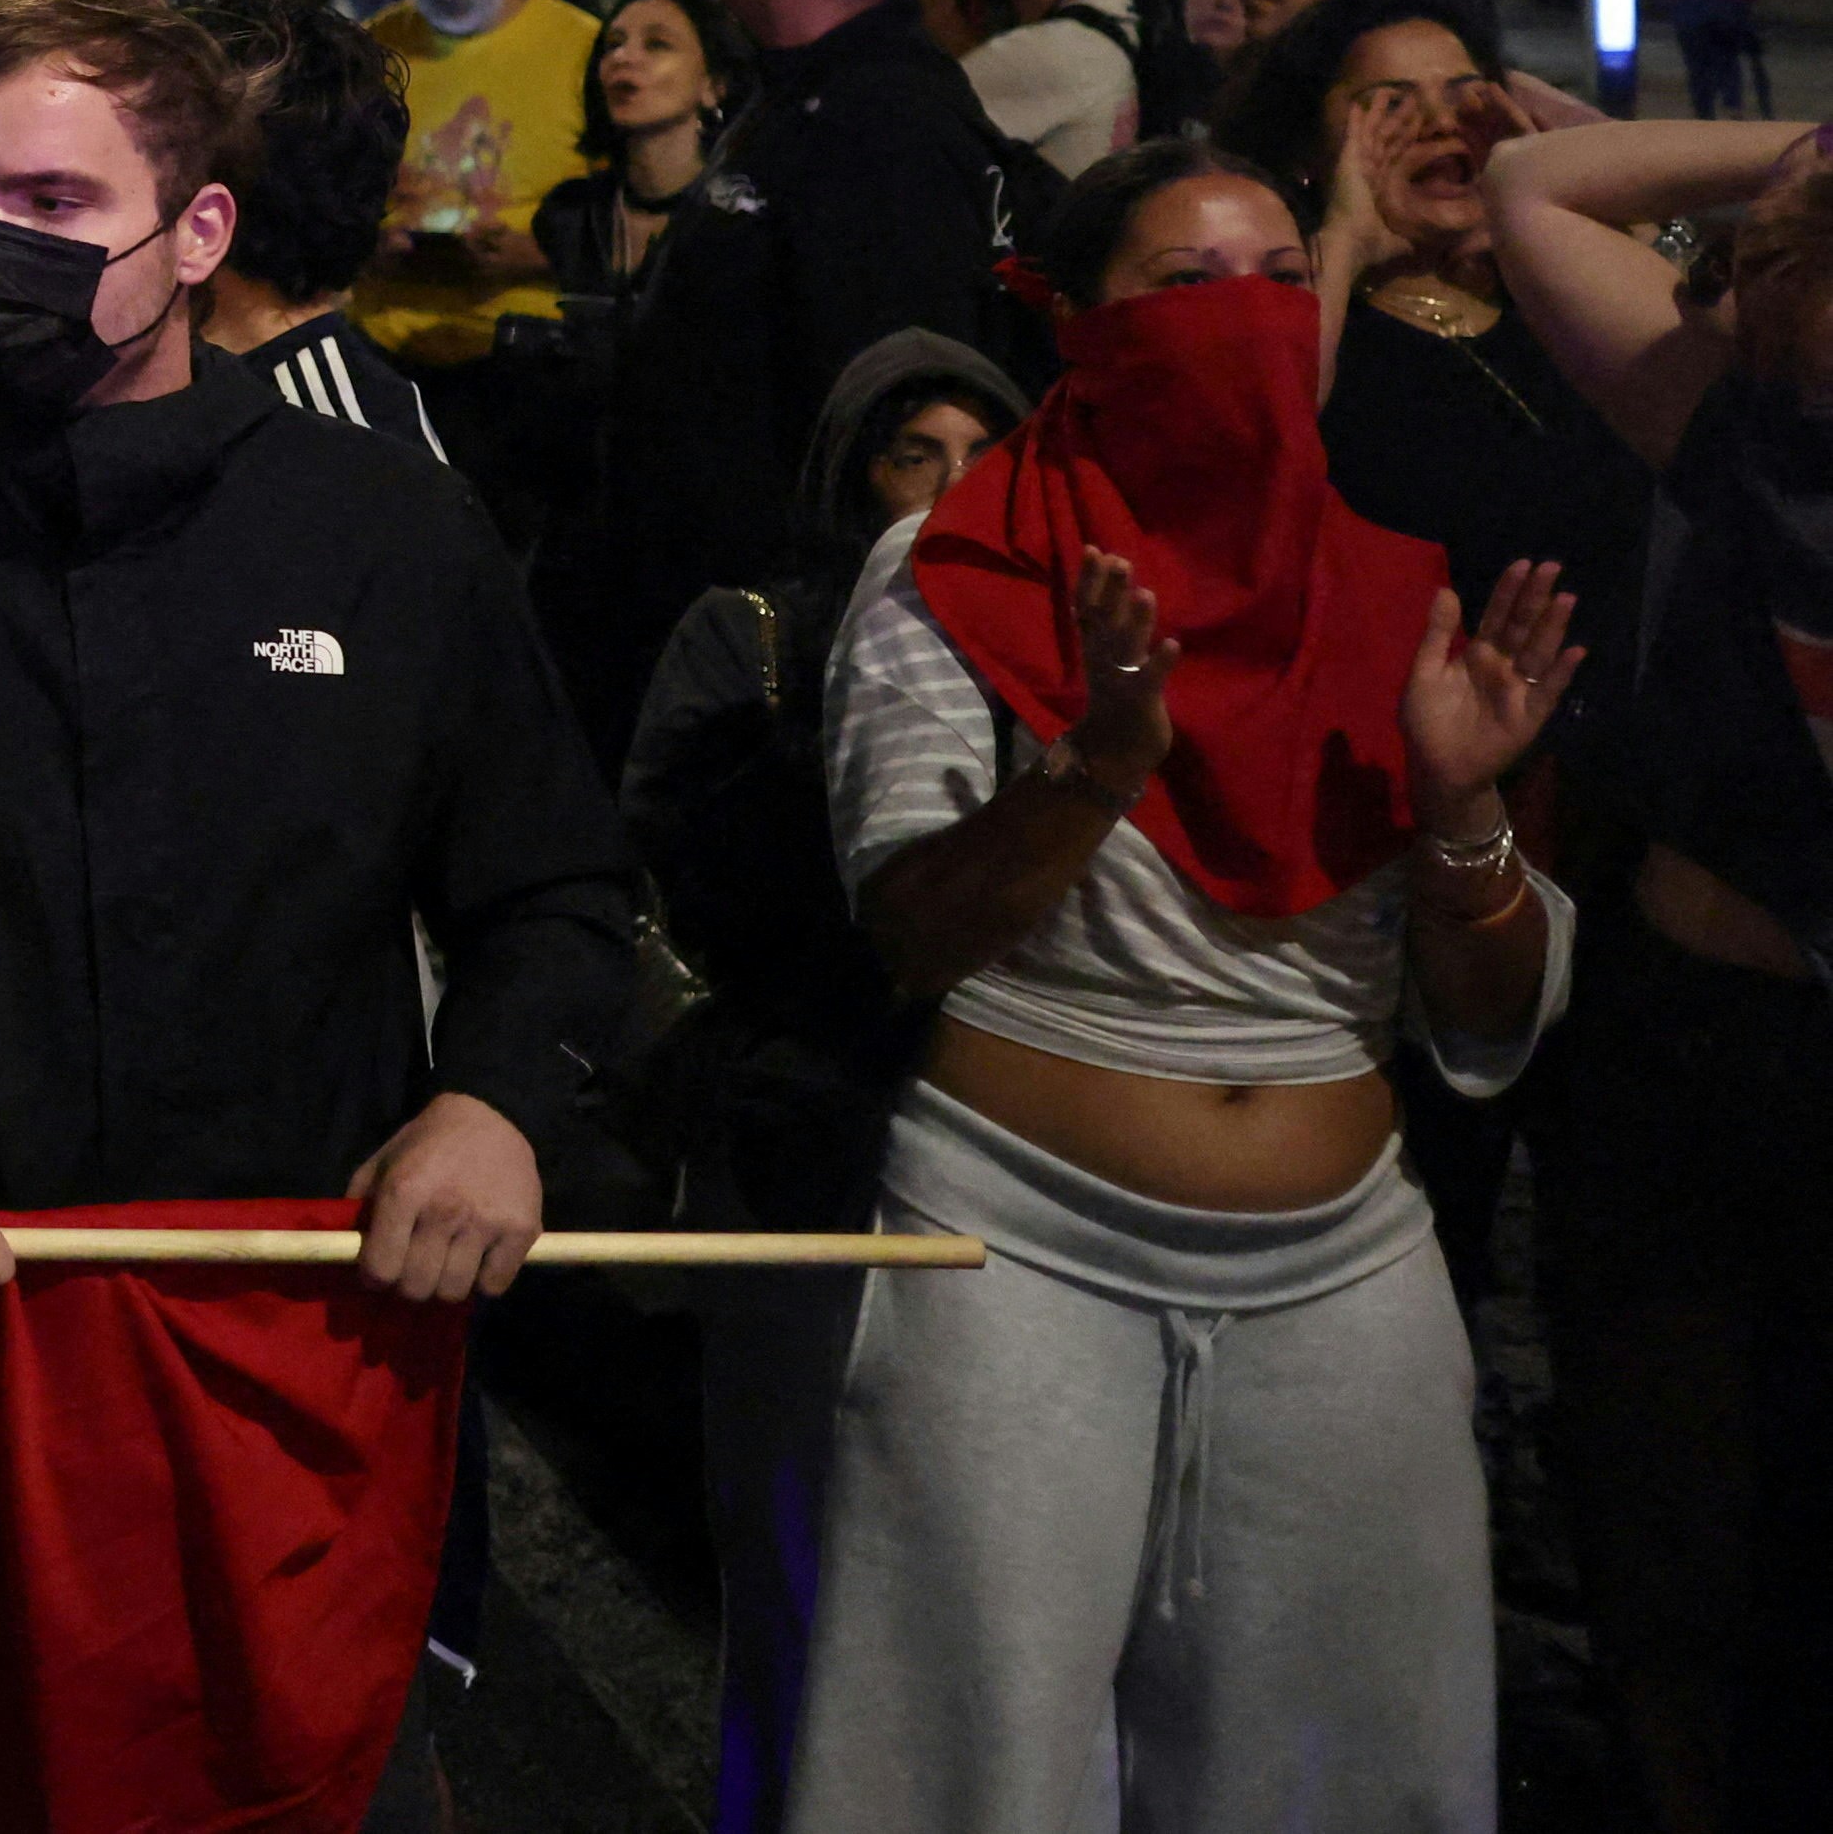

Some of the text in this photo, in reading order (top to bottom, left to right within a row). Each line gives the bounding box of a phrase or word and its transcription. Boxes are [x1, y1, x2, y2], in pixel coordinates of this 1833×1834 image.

[278, 628, 314, 644] THE
[253, 641, 315, 659] NORTH
[270, 657, 315, 674] FACE
